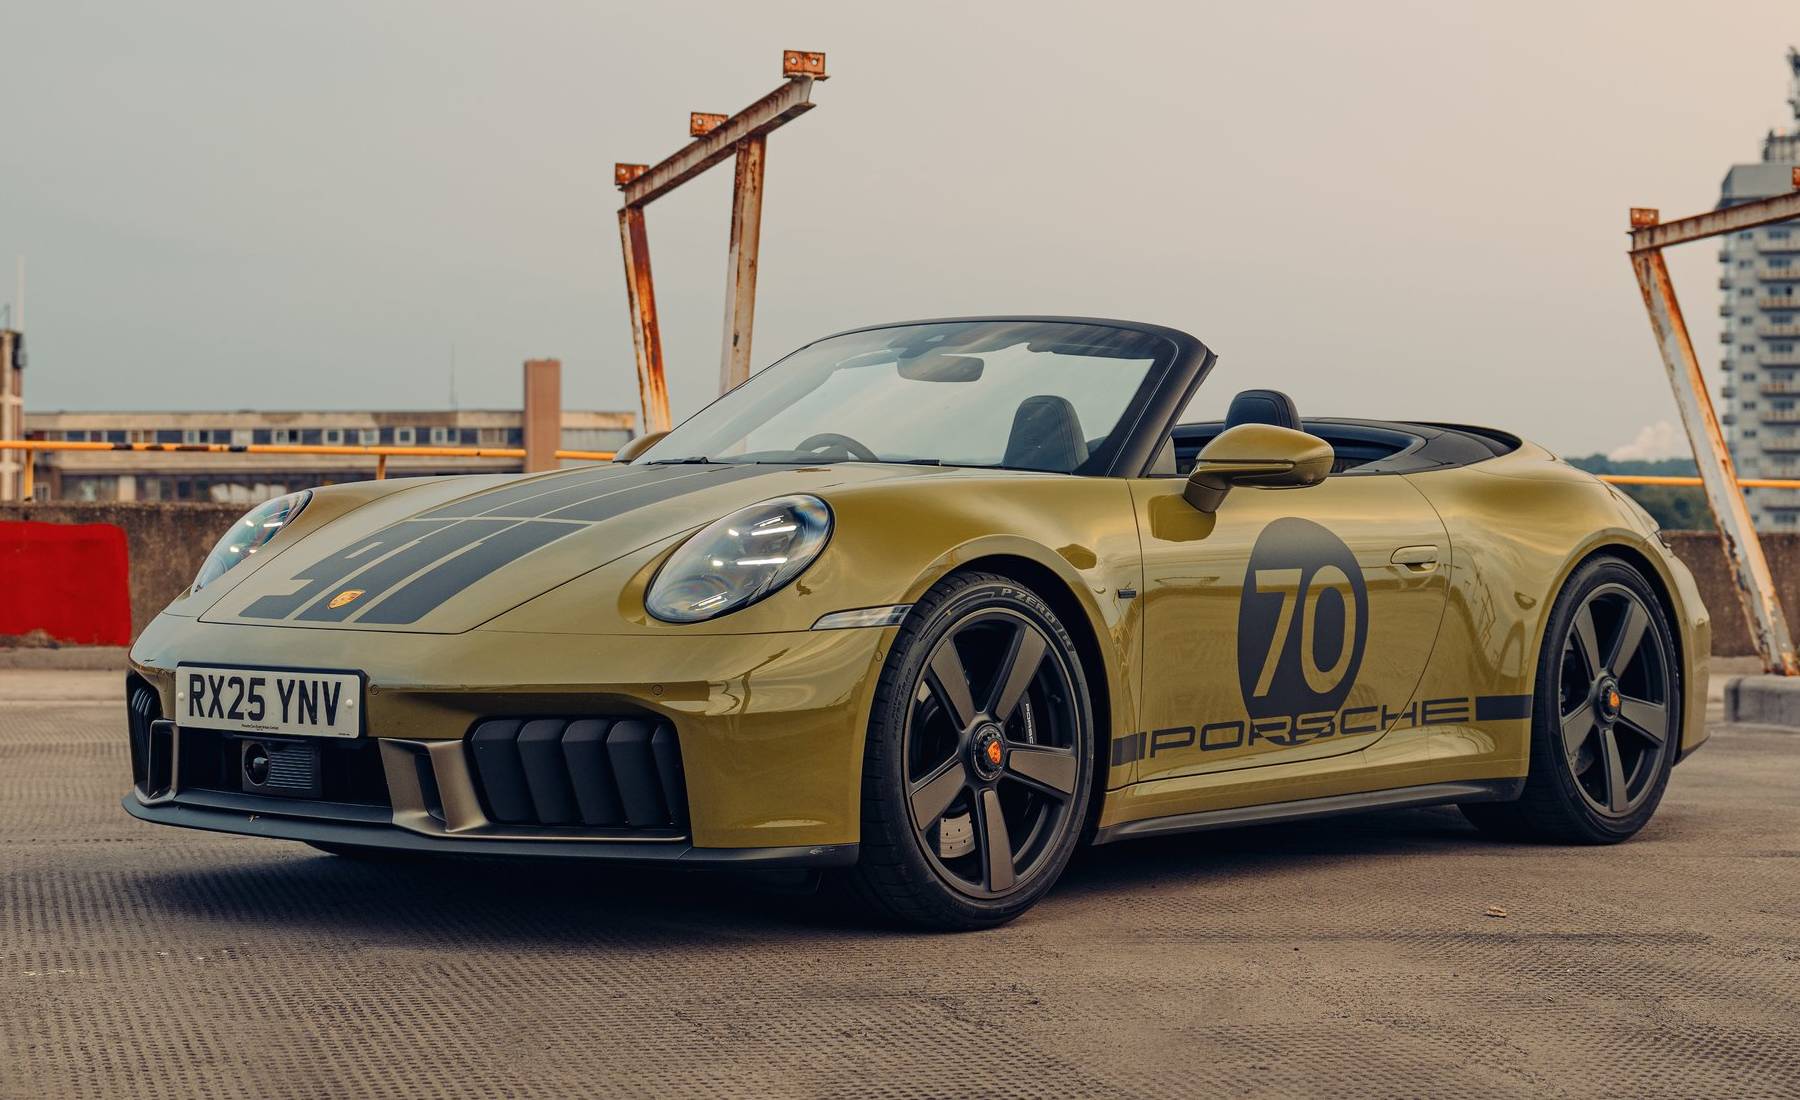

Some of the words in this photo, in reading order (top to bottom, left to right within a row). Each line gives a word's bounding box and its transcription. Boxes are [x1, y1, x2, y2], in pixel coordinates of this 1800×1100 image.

[1001, 588, 1012, 597] P
[1015, 591, 1056, 624] ZERO
[1253, 565, 1356, 697] 70
[189, 674, 266, 722] RX25
[276, 678, 342, 726] YNV
[1150, 698, 1470, 759] PORSCHE
